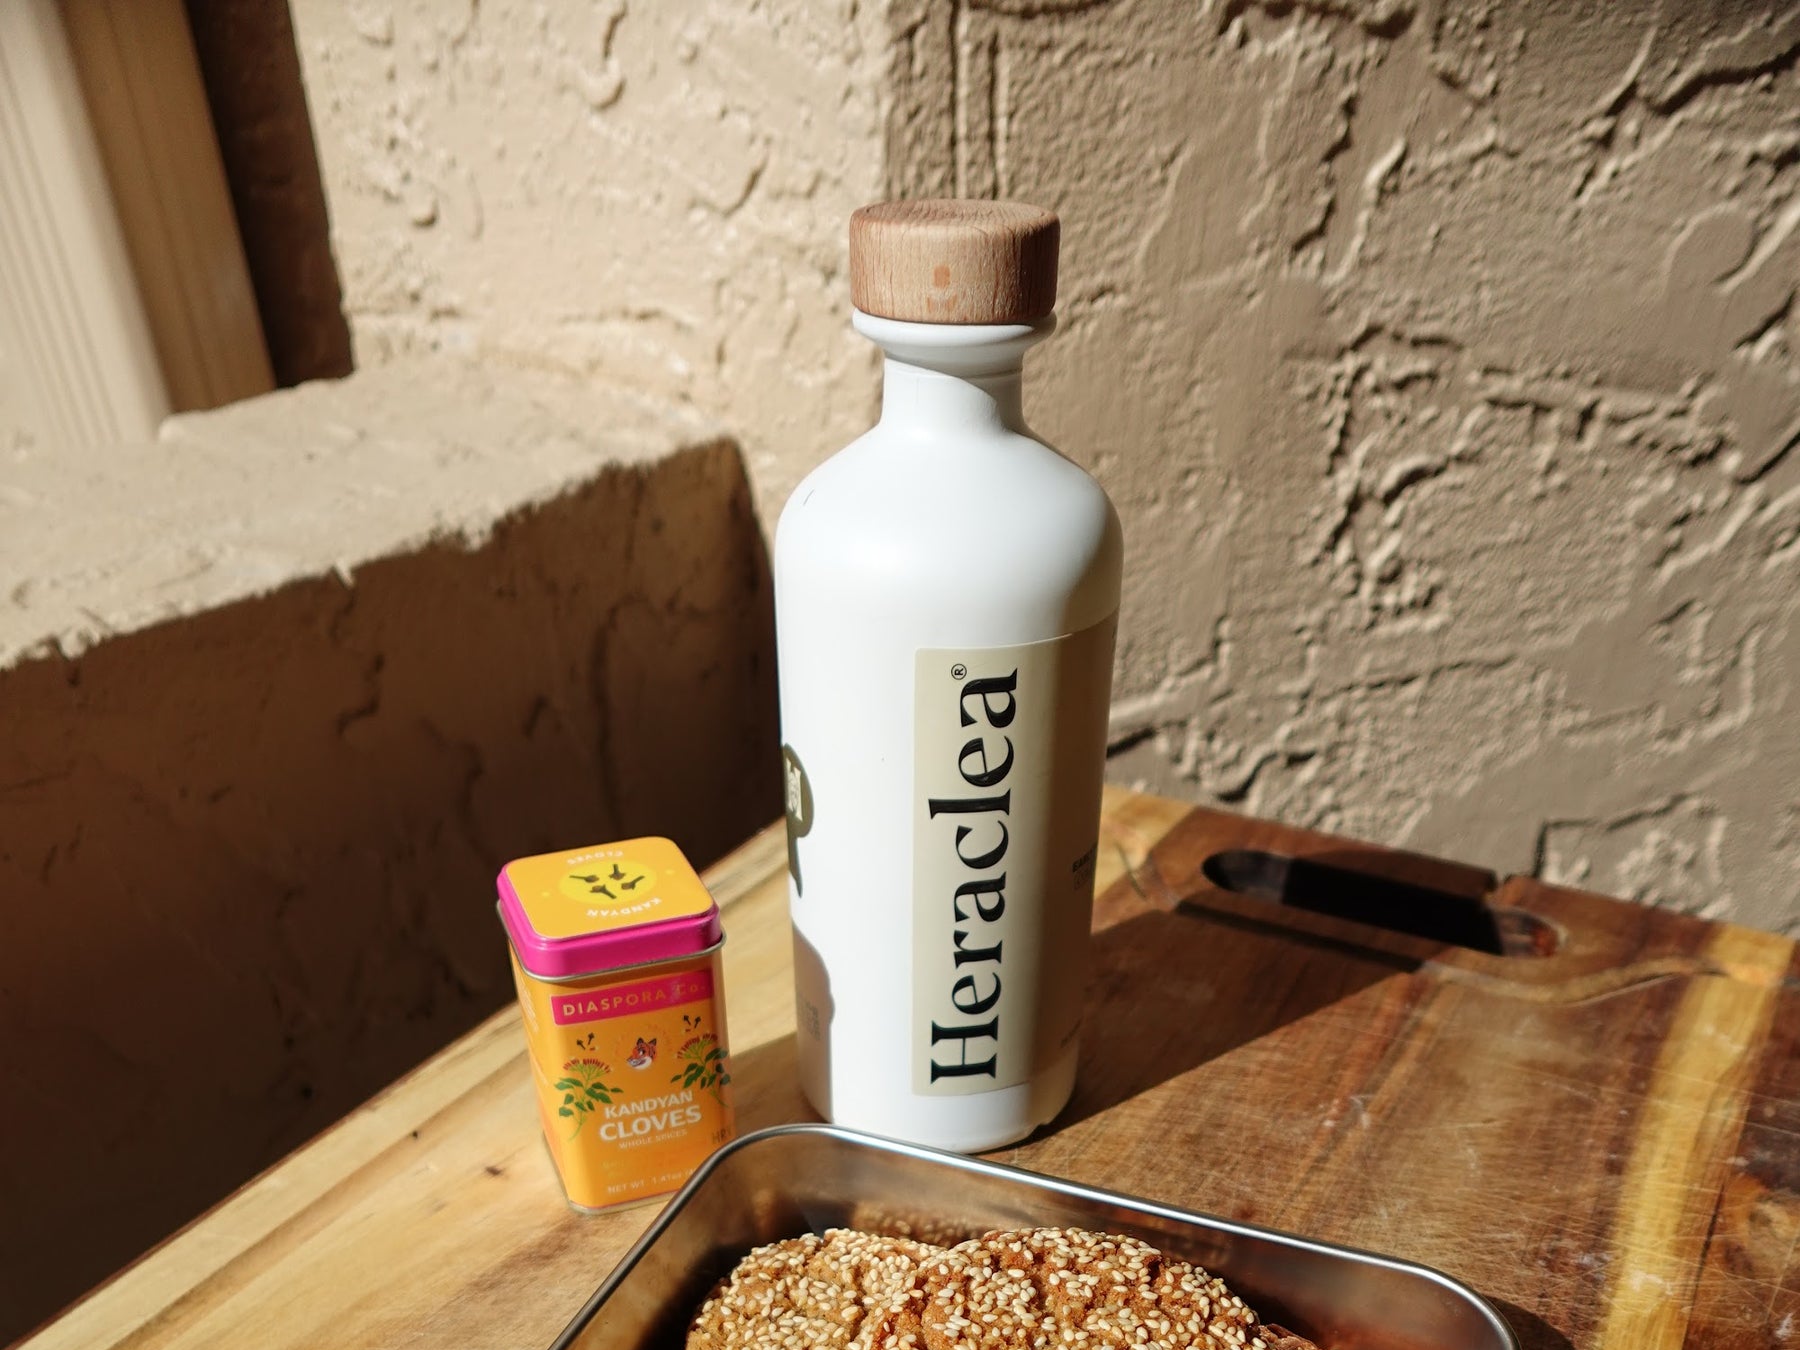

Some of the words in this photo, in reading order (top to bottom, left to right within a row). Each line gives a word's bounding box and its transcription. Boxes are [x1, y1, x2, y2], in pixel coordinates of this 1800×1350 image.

[566, 850, 624, 865] CLOVES
[586, 897, 662, 917] KANDYAN
[562, 989, 666, 1016] DIASPORA
[604, 1090, 694, 1119] KANDYAN
[600, 1105, 702, 1141] CLOVES
[619, 1136, 652, 1149] WHOLE
[607, 1184, 627, 1194] NET
